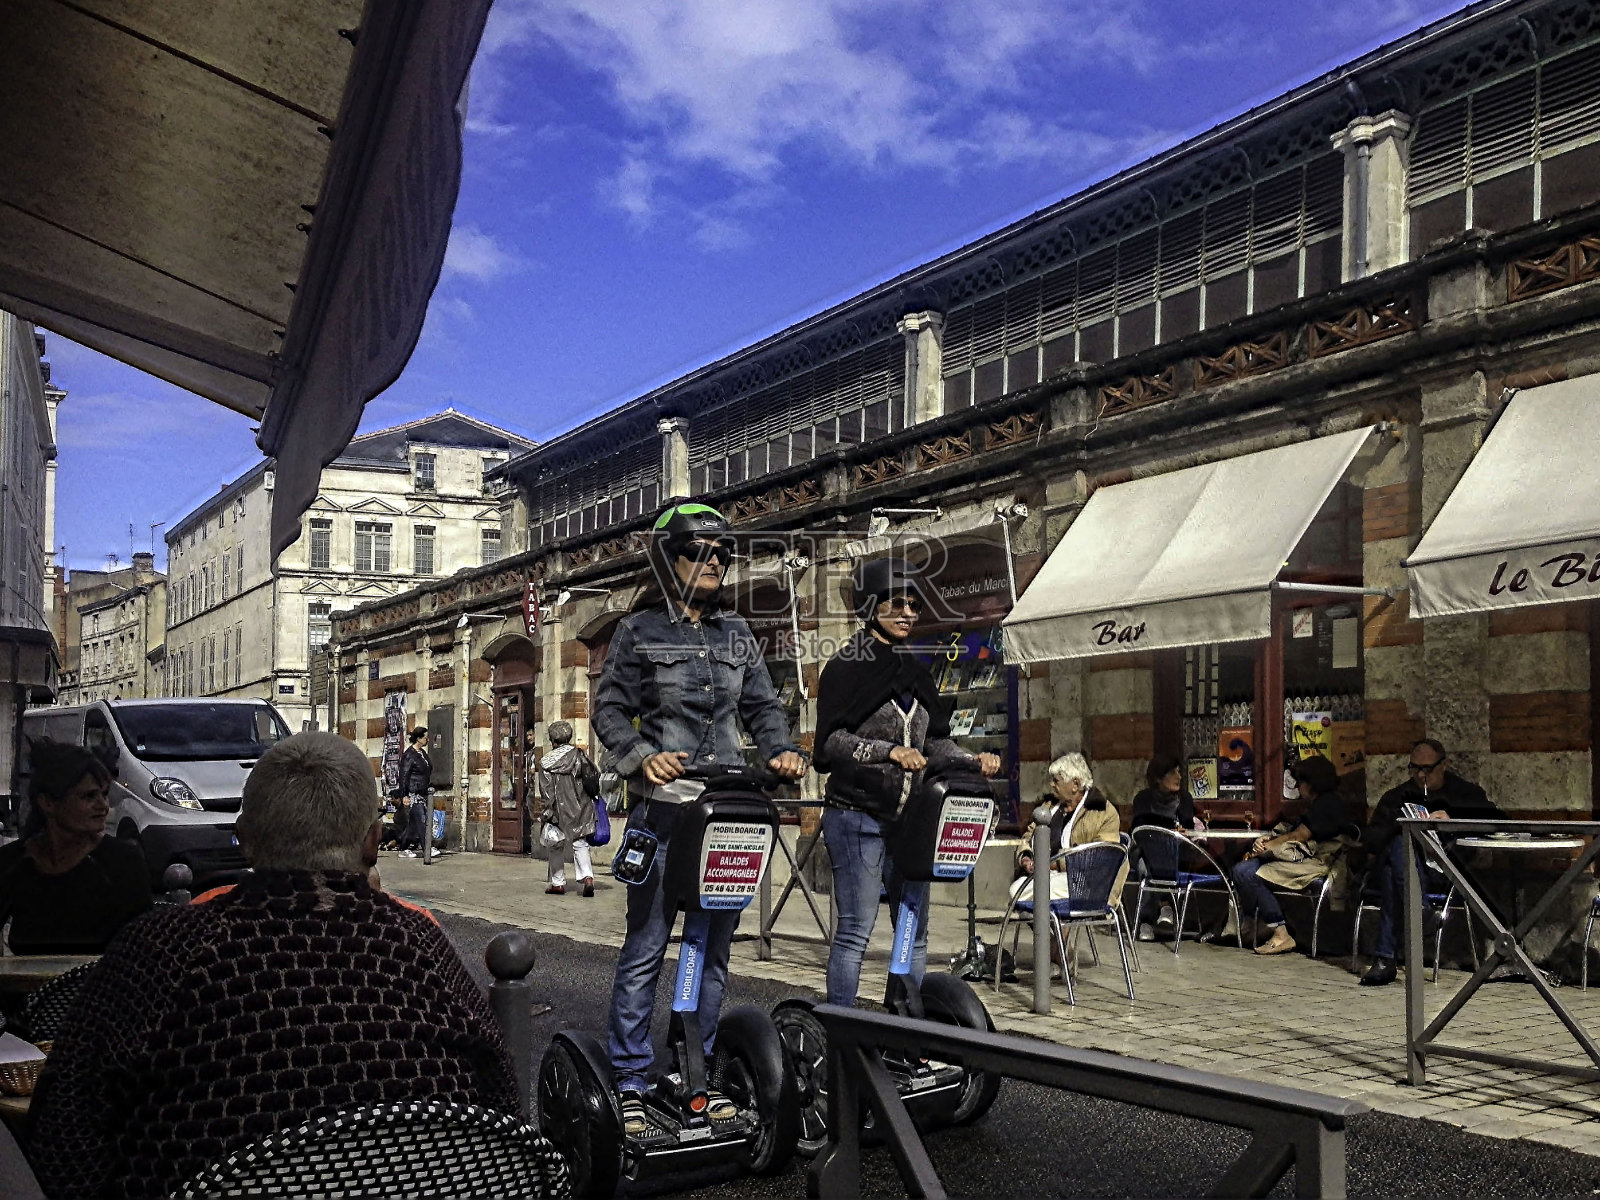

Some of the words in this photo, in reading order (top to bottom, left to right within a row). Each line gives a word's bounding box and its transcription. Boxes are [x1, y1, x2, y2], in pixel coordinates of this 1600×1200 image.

[940, 585, 965, 599] Tabac
[968, 582, 980, 594] du
[528, 582, 536, 633] TABAC
[1091, 620, 1146, 646] Bar
[713, 826, 759, 834] MOBILBOARD
[951, 828, 975, 837] BALADES
[720, 856, 749, 866] BALADES
[706, 868, 758, 878] ACCOMPAGNÉES
[704, 884, 714, 892] 05
[725, 884, 735, 893] 43
[746, 885, 756, 893] 55
[900, 911, 914, 963] MOBILBOARD
[682, 944, 697, 1000] MOBILBOARD
